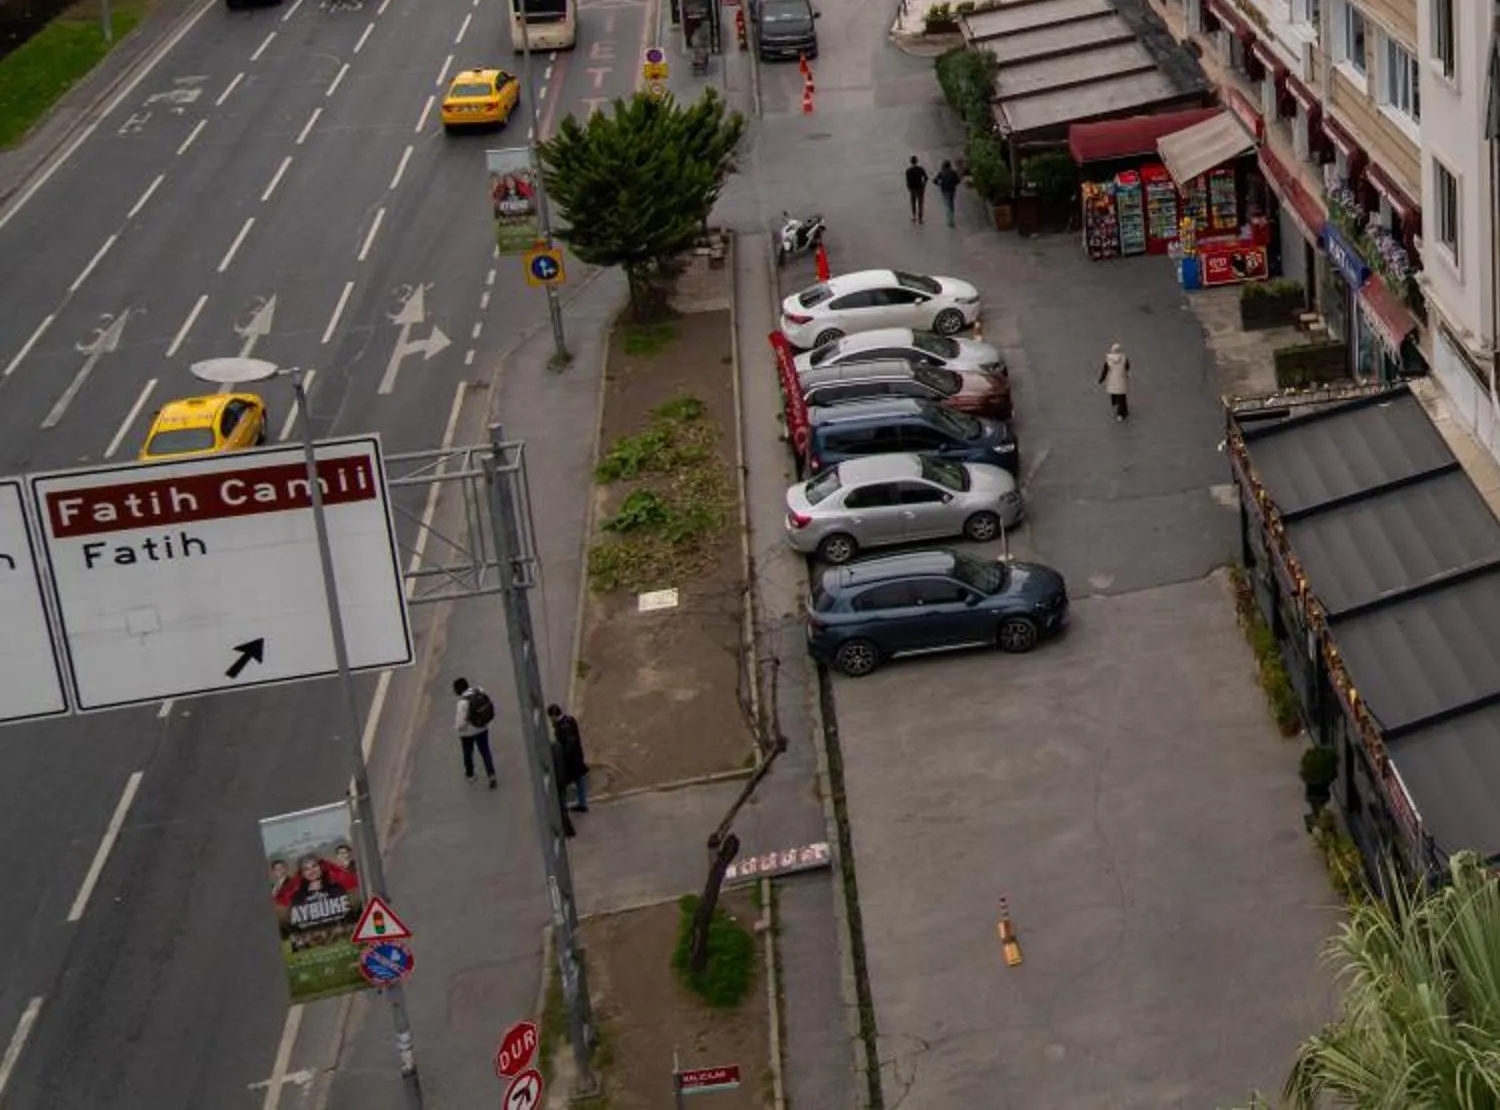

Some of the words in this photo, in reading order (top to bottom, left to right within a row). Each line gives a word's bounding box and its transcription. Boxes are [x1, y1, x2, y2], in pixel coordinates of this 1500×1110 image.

[57, 486, 200, 528] Fatih
[219, 465, 368, 506] Camii
[82, 531, 208, 569] Fatih
[499, 1029, 536, 1071] DUR
